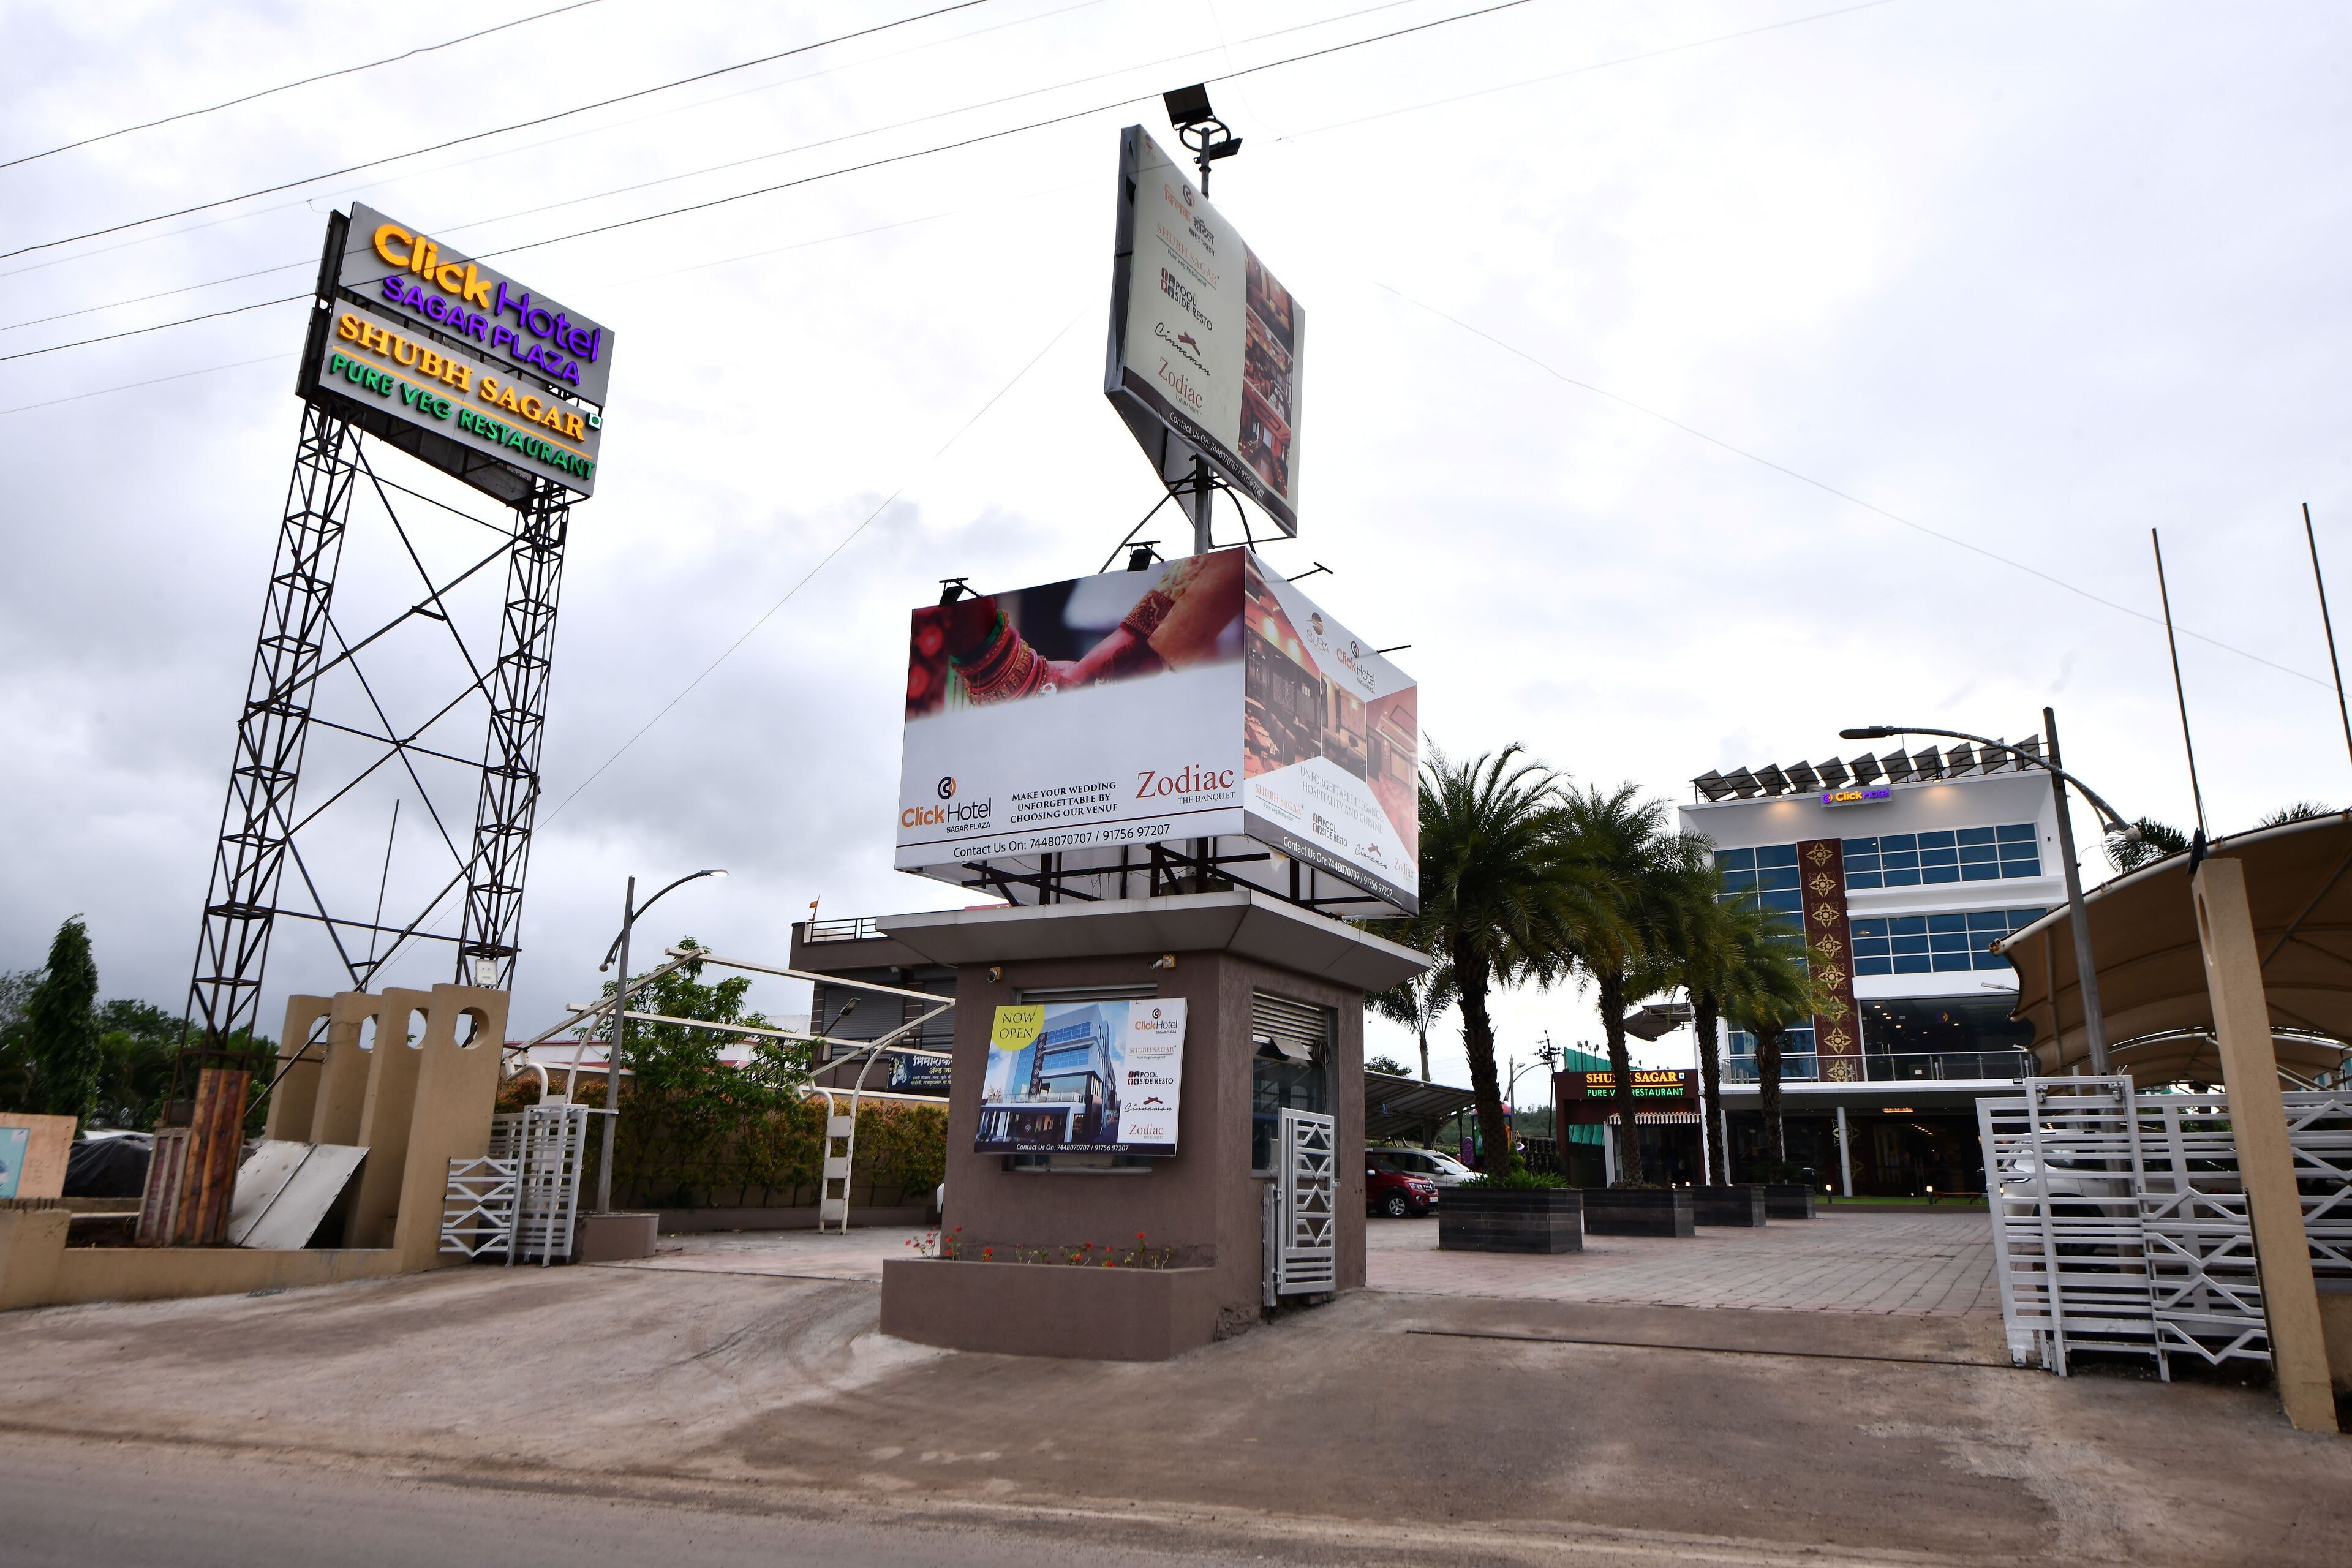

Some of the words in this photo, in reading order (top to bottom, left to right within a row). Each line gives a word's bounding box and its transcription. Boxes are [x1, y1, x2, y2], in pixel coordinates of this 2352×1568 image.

[1157, 222, 1188, 258] SHUBH
[1190, 252, 1216, 285] SAGAR
[1167, 249, 1177, 260] Pure
[1186, 265, 1207, 287] Restaurant
[372, 224, 492, 309] Click
[494, 281, 601, 363] Hotel
[1175, 280, 1197, 306] POOL
[1175, 291, 1191, 312] SIDE
[1192, 308, 1213, 331] RESTO
[382, 274, 488, 342] SAGAR
[491, 325, 580, 386] PLAZA
[1155, 322, 1211, 377] Cinnamon
[337, 313, 473, 393] SHUBH
[479, 375, 586, 442] SAGAR
[1158, 356, 1203, 409] Zodiac
[330, 353, 394, 398] PURE
[399, 382, 452, 421] VEG
[458, 409, 595, 481] RESTAURANT
[1183, 399, 1202, 418] BANQUET
[1170, 412, 1192, 434] Contact
[1193, 428, 1200, 440] Us
[1200, 435, 1210, 448] On:
[1211, 442, 1239, 472] 7448070707
[1241, 470, 1253, 487] 91756
[1253, 481, 1264, 499] 97207
[1306, 629, 1330, 657] SUBA
[1336, 647, 1356, 674] Click
[1357, 662, 1375, 688] Hotel
[1011, 791, 1038, 802] MAKE
[1041, 788, 1066, 797] YOUR
[1069, 781, 1117, 795] WEDDING
[1136, 764, 1235, 799] Zodiac
[1300, 766, 1353, 804] UNFORGETTABLE
[1835, 791, 1863, 802] Click
[1863, 787, 1891, 800] Hotel
[1017, 796, 1096, 812] UNFORGETTABLE
[1099, 793, 1111, 802] BY
[1196, 791, 1235, 804] BANQUET
[1256, 783, 1279, 804] SHUBH
[1281, 796, 1302, 815] SAGAR
[1302, 781, 1343, 810] HOSPITALITY
[1344, 805, 1358, 820] AND
[1359, 813, 1382, 834] CUISINE
[902, 805, 945, 827] Click
[947, 797, 992, 823] Hotel
[1010, 809, 1061, 823] CHOOSING
[1063, 808, 1084, 816] OUR
[1086, 804, 1118, 815] VENUE
[1322, 818, 1336, 833] POOL
[946, 824, 968, 834] SAGAR
[969, 821, 991, 831] PLAZA
[954, 845, 991, 858] Contact
[993, 842, 1006, 853] Us
[1009, 840, 1027, 851] On:
[1030, 832, 1092, 849] 7448070707
[1102, 827, 1134, 841] 91756
[1137, 824, 1170, 838] 97207
[1322, 828, 1332, 840] SIDE
[1333, 833, 1348, 847] RESTO
[1283, 836, 1306, 856] Contact
[1308, 847, 1315, 860] Us
[1316, 852, 1327, 866] On:
[1328, 858, 1360, 881] 7448070707
[1363, 876, 1378, 890] 91756
[1378, 884, 1393, 898] 97207
[1355, 843, 1387, 870] Cinnamon
[1395, 858, 1414, 879] Zodiac
[1002, 1011, 1036, 1024] NOW
[1135, 1021, 1155, 1030] Click
[1156, 1019, 1177, 1030] Hotel
[1000, 1028, 1033, 1039] OPEN
[1635, 1072, 1678, 1083] SAGAR
[1124, 1102, 1172, 1113] Cinnamon
[1129, 1123, 1164, 1135] Zodiac
